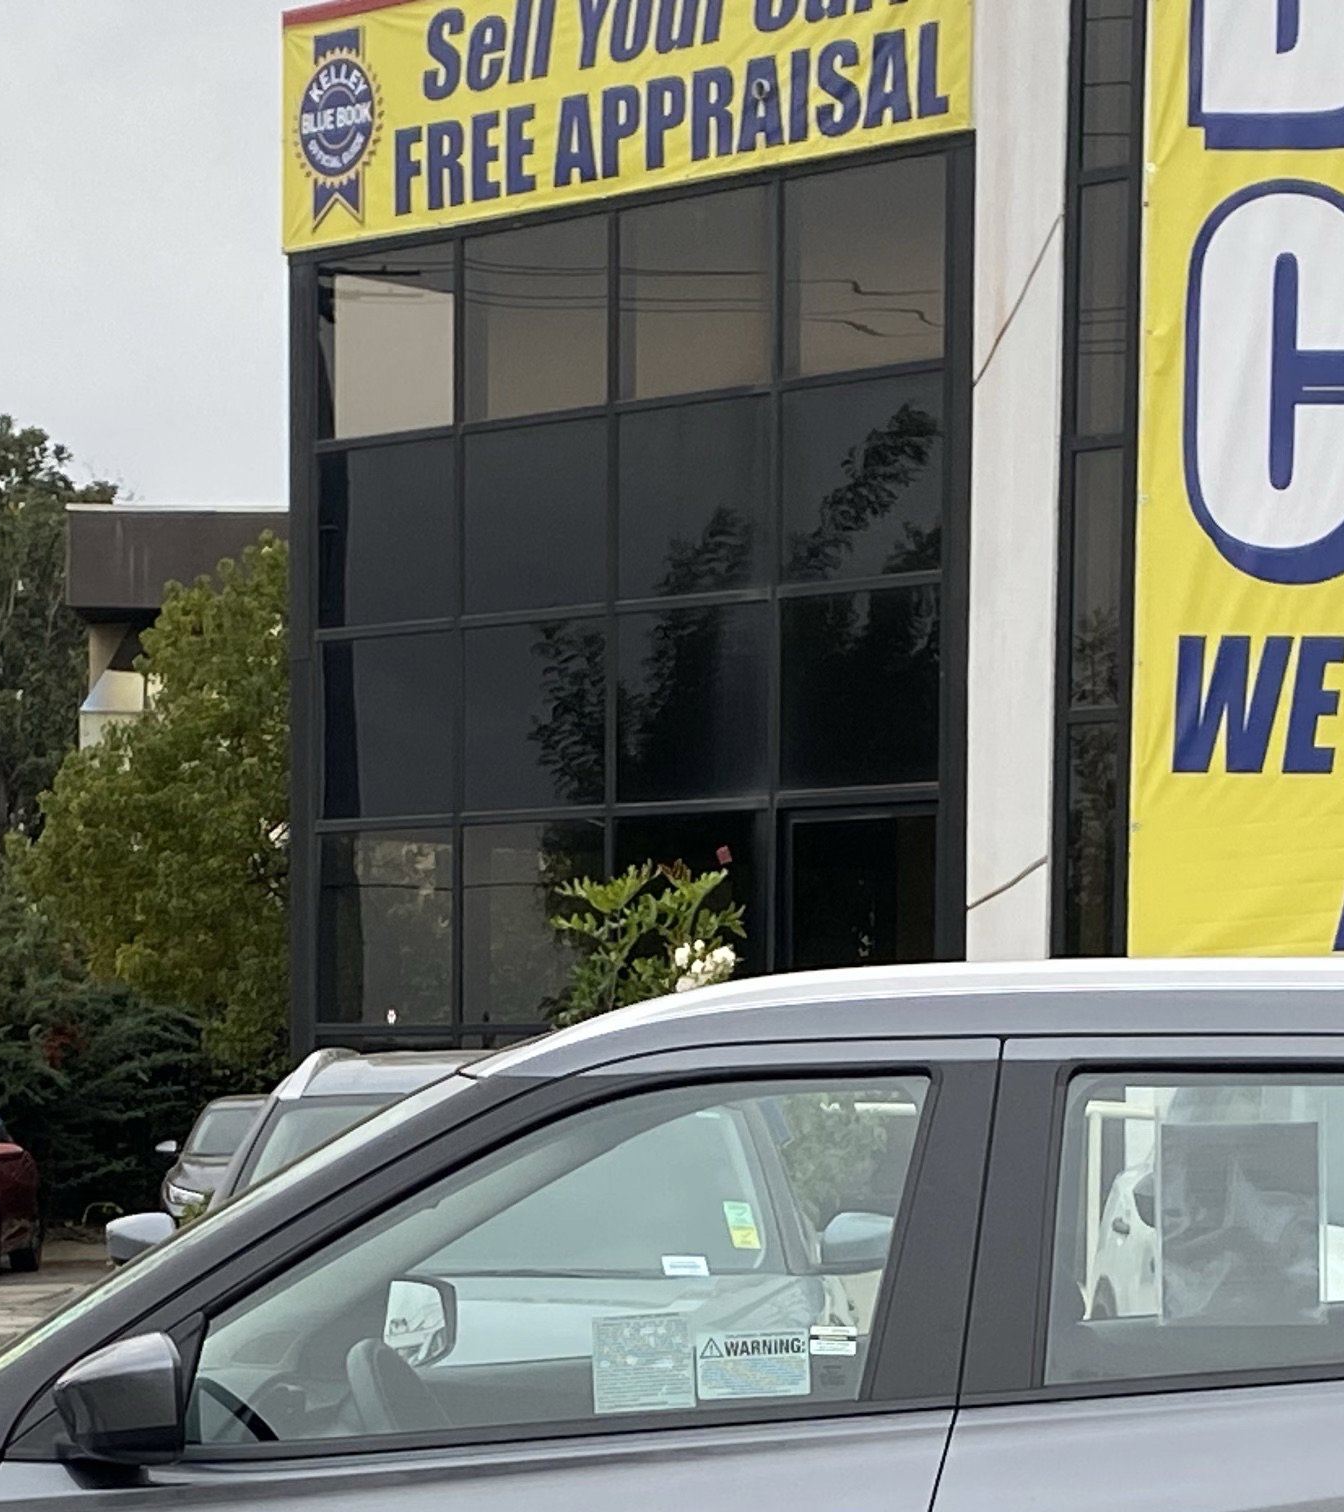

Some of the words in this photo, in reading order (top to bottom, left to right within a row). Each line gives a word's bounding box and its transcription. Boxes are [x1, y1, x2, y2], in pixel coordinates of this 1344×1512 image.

[309, 63, 368, 103] KELLEY
[423, 0, 555, 100] Sell
[302, 108, 335, 135] BLUE
[336, 101, 372, 128] BOOK
[394, 104, 537, 216] FREE
[553, 22, 952, 189] APPRAISAL
[1172, 636, 1340, 774] WE
[724, 1337, 806, 1358] WARNING:
